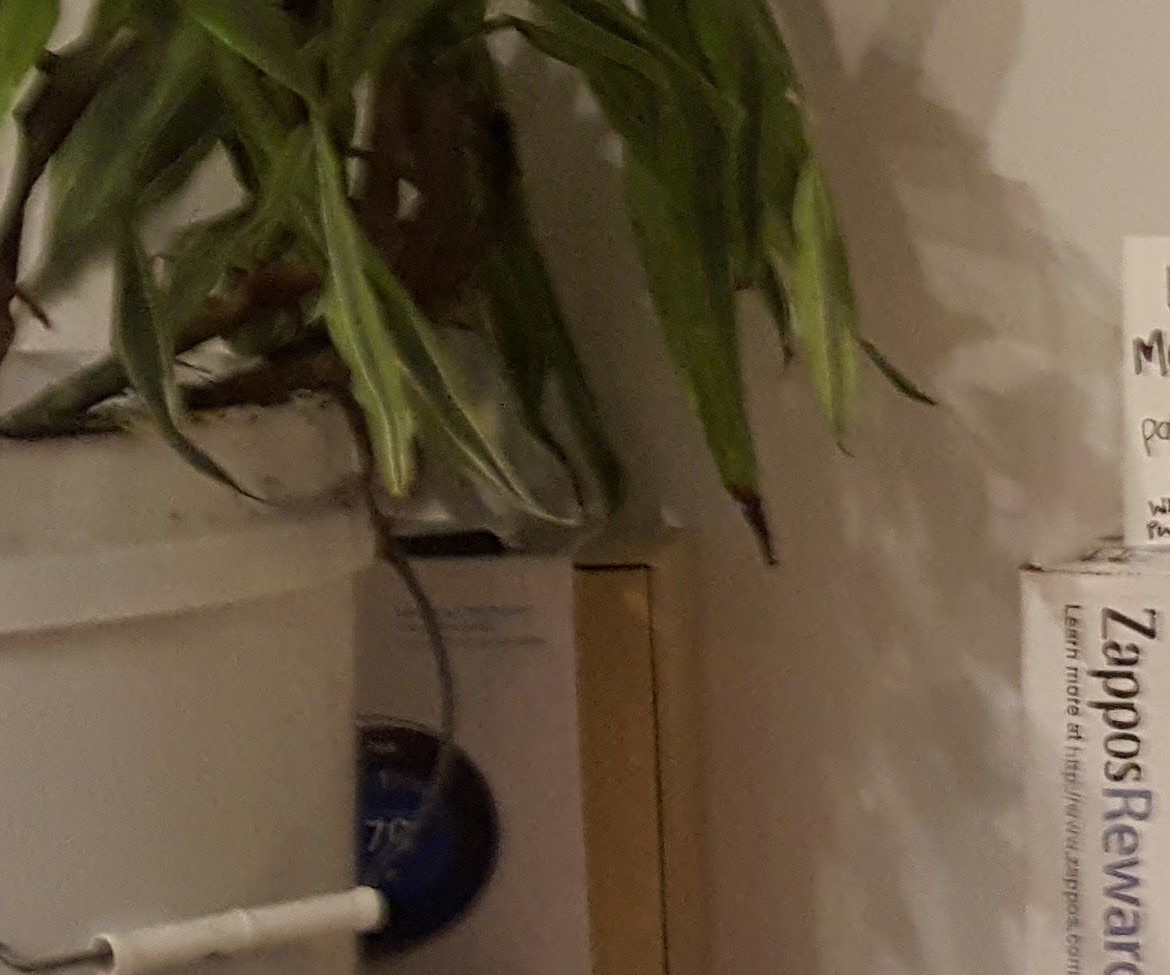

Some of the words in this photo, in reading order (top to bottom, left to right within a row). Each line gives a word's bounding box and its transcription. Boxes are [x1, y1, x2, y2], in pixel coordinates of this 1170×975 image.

[1064, 604, 1082, 660] Learn
[1065, 666, 1082, 716] more
[1066, 722, 1083, 741] at
